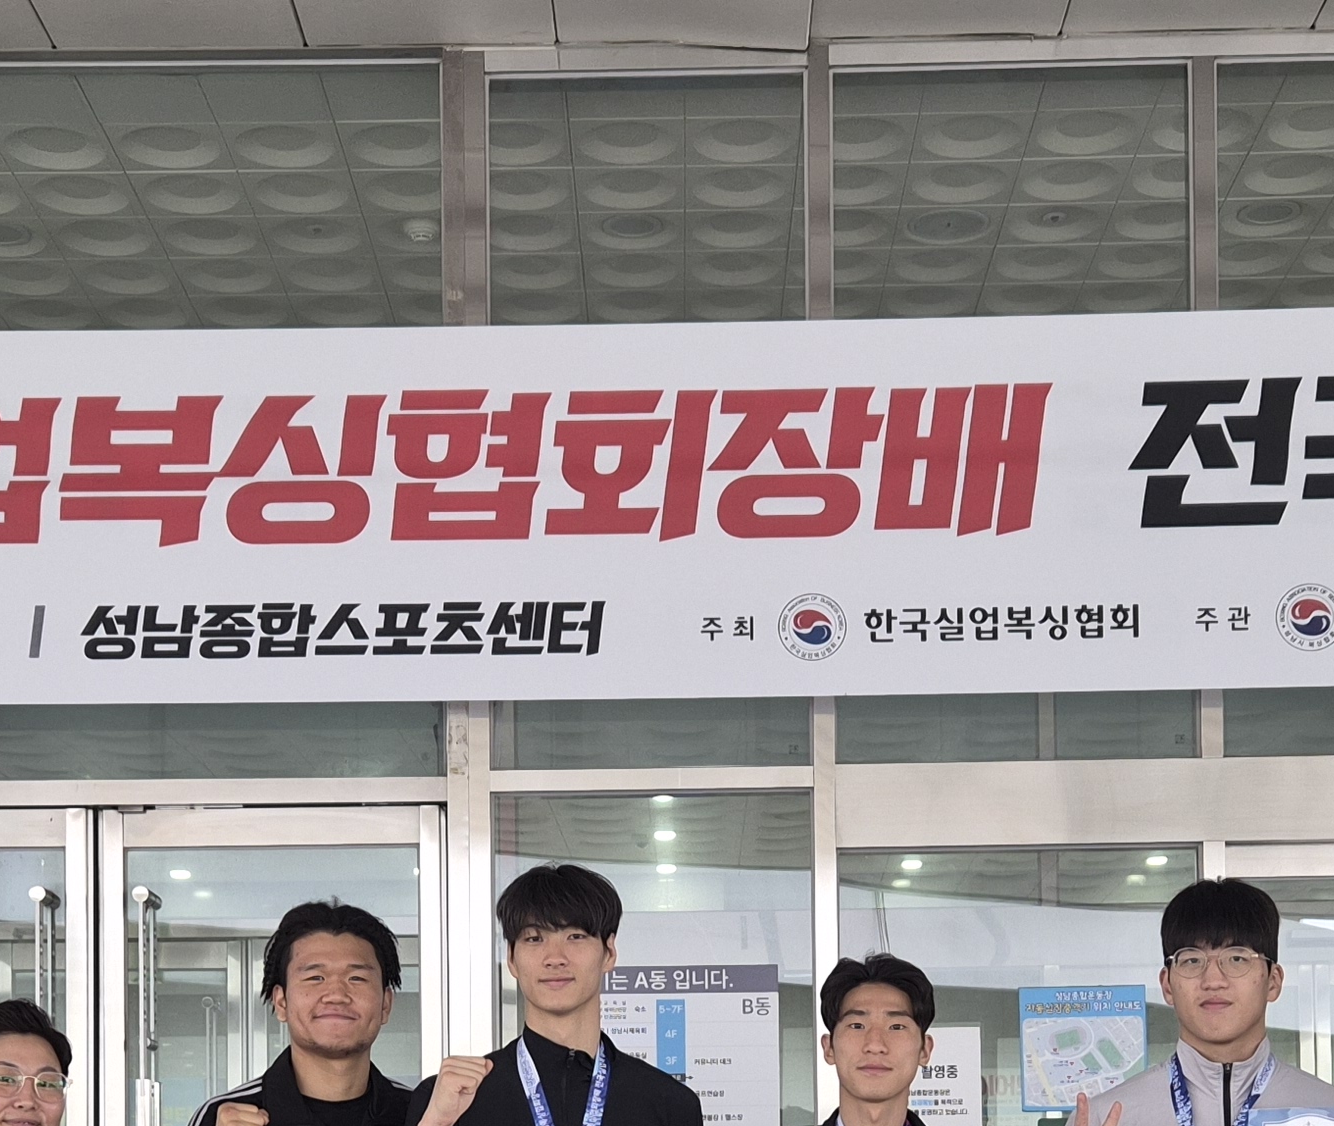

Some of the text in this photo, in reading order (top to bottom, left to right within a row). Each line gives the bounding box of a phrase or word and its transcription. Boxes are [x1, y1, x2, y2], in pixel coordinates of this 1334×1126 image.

[701, 604, 1140, 642] 주최 한국실업복싱협회
[1196, 606, 1251, 632] 주관
[80, 601, 605, 660] 성남종합스포츠센터
[634, 970, 667, 990] A동
[673, 968, 733, 990] 입니다.
[742, 997, 771, 1016] B동
[665, 1030, 678, 1040] 4F
[665, 1056, 678, 1066] 3F
